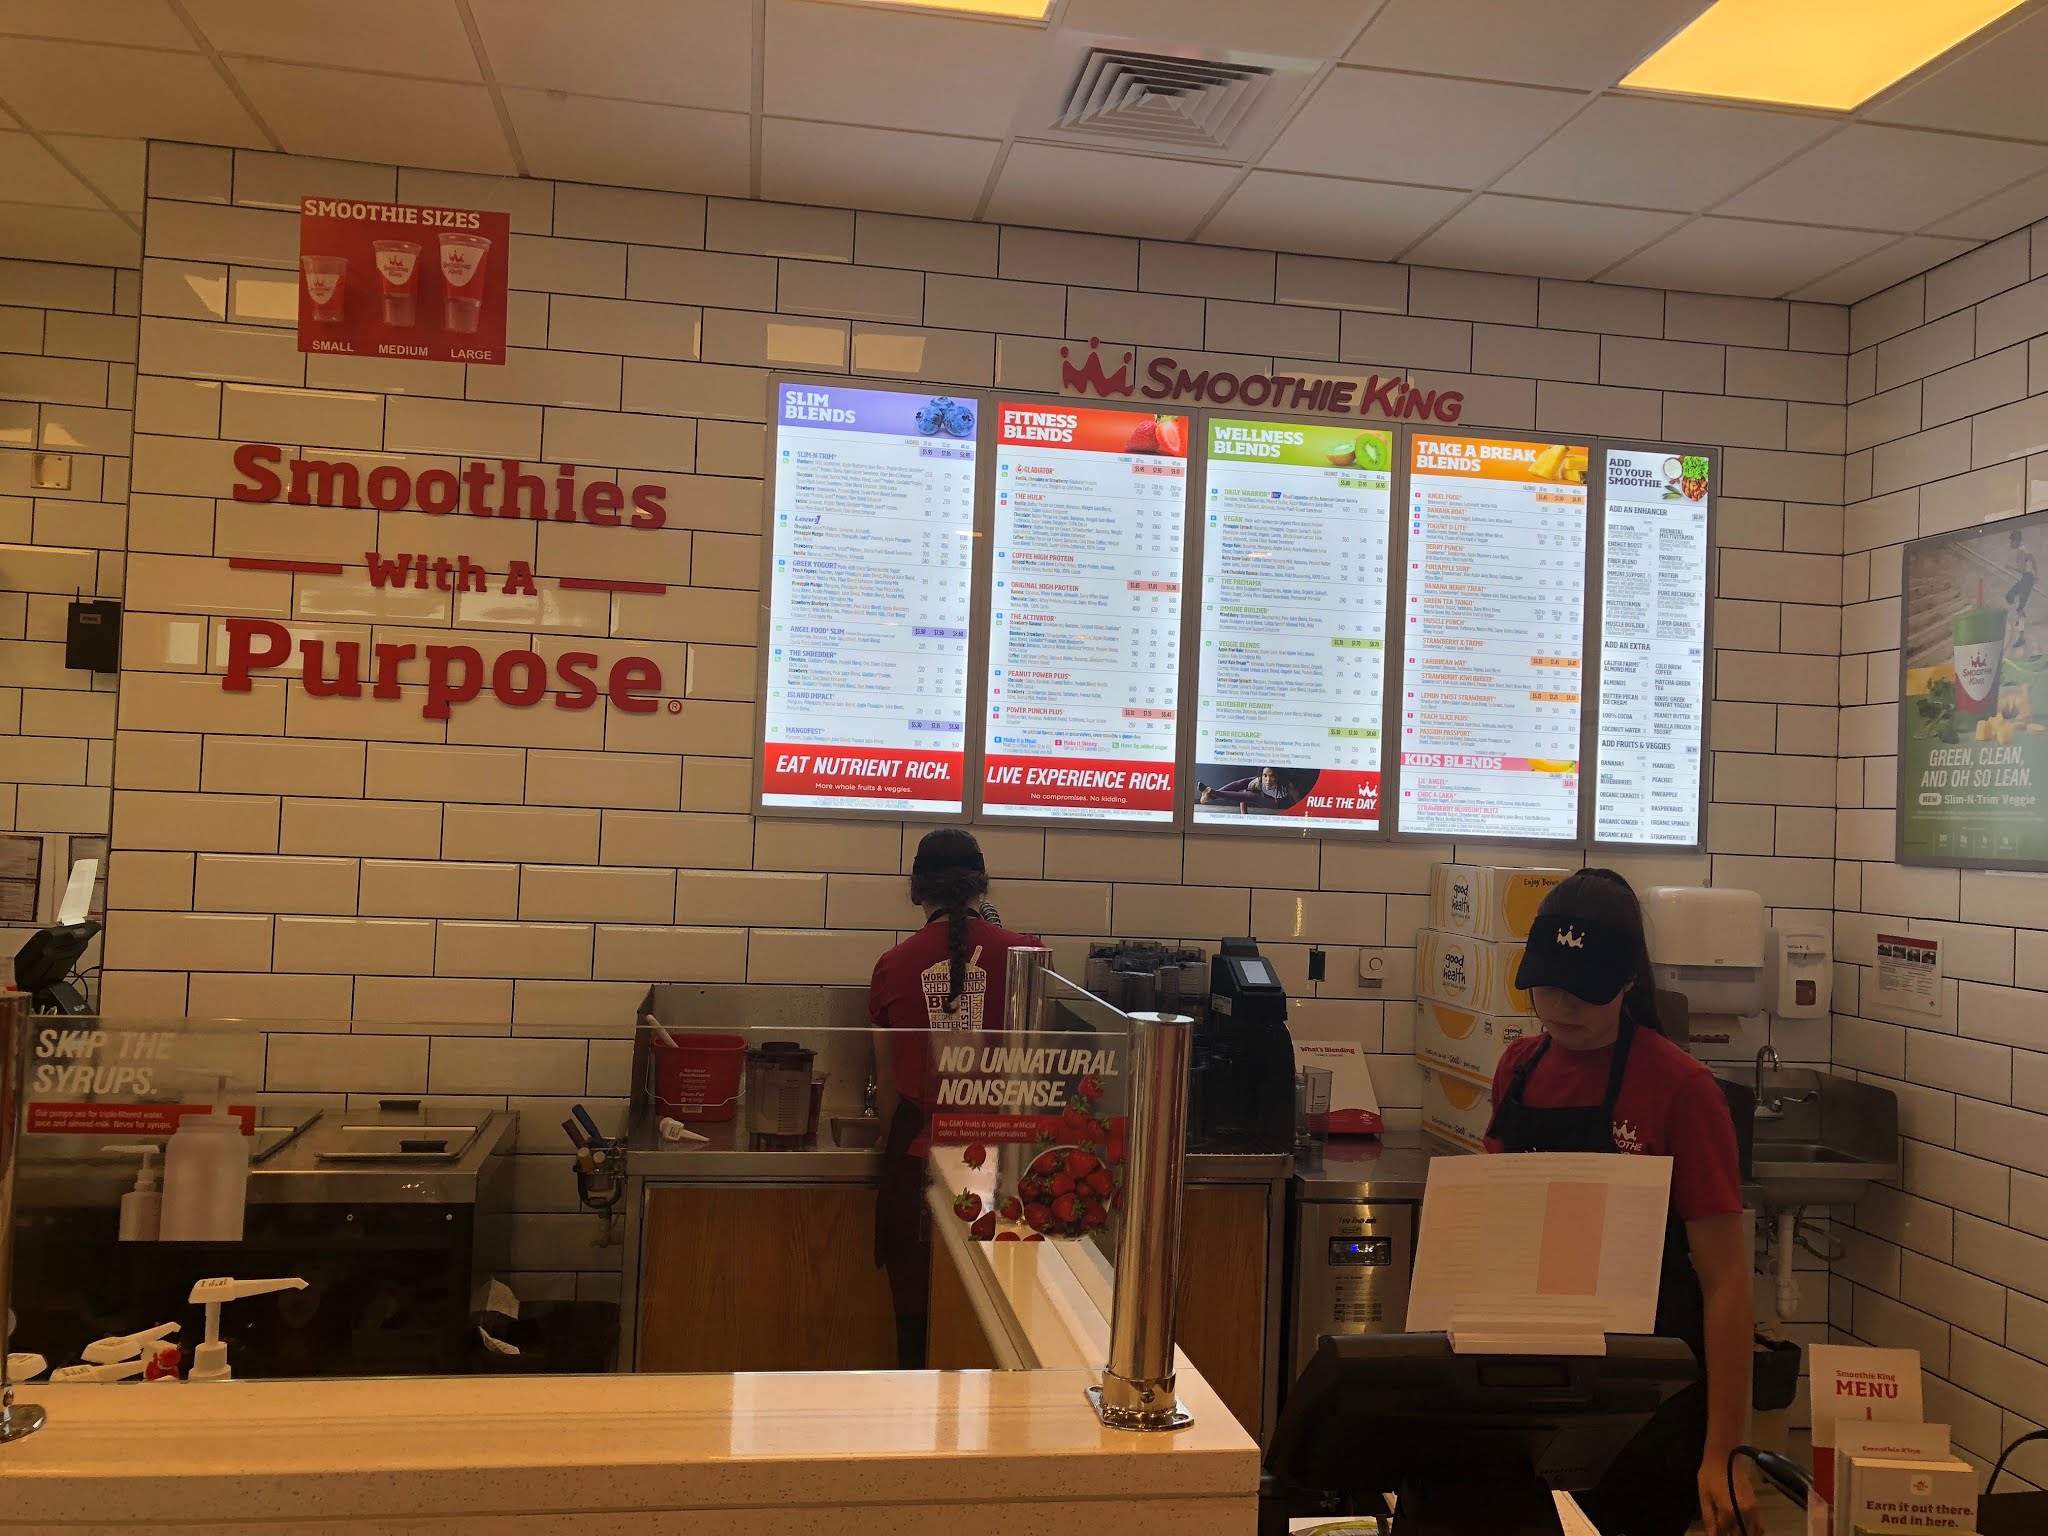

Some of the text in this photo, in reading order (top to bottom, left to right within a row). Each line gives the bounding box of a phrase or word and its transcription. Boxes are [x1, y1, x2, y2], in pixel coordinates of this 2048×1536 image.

[305, 200, 480, 228] SMOOTHIE SIZES
[312, 340, 354, 352] SMALL
[379, 344, 428, 356] MEDIUM
[451, 349, 492, 360] LARGE
[1141, 357, 1357, 413] SMOOTHIE
[786, 391, 829, 407] SLIM
[785, 405, 856, 423] BLENDS
[1004, 411, 1077, 428] FITNESS
[1004, 425, 1072, 442] BLENDS
[1215, 427, 1303, 445] WELLNESS
[1214, 441, 1280, 457] BLENDS
[1417, 441, 1536, 462] TAKE A BREAK
[1417, 455, 1481, 472] BLENDS
[1610, 458, 1631, 467] ADD
[1625, 469, 1652, 478] YOUR
[232, 444, 667, 529] Smoothies
[1609, 476, 1662, 488] SMOOTHIE
[1634, 507, 1667, 516] ENHANCER
[793, 560, 812, 568] GREEK
[365, 552, 538, 595] With A
[1630, 642, 1650, 650] EXTRA
[222, 619, 662, 720] Purpose
[811, 692, 833, 700] IMPACT
[1646, 742, 1671, 750] VEGGIES
[1404, 754, 1502, 769] KIDS BLENDS
[1930, 746, 2024, 768] GREEN, CLEAN,
[776, 755, 951, 779] EAT NUTRIENT RICH.
[987, 766, 1171, 790] LIVE EXPERIENCE RICH.
[1921, 768, 2032, 787] AND OH SO LEAN.
[884, 785, 912, 794] veggies.
[1043, 793, 1088, 802] compromises.
[1307, 797, 1332, 808] RULE
[1335, 798, 1354, 809] THE
[1945, 795, 1999, 804] Slim-N-Trim
[2002, 795, 2035, 806] Veggie
[1524, 879, 1539, 887] Enjoy
[1454, 885, 1468, 898] good
[1452, 897, 1470, 913] health
[1446, 954, 1464, 968] good
[964, 972, 985, 980] RDER
[1443, 967, 1466, 984] health
[925, 983, 948, 992] SHED
[972, 995, 982, 1019] STRESS
[36, 1030, 177, 1059] SKIP THE
[938, 1046, 1119, 1076] NO UNNATURAL
[33, 1065, 157, 1095] SYRUPS.
[937, 1080, 1067, 1106] NONSENSE.
[1013, 1121, 1036, 1129] artificial
[1836, 1370, 1896, 1382] Smoothie King
[1836, 1380, 1898, 1399] MENU
[1867, 1501, 1974, 1516] Earn it out there.
[1881, 1515, 1958, 1527] And in here.
